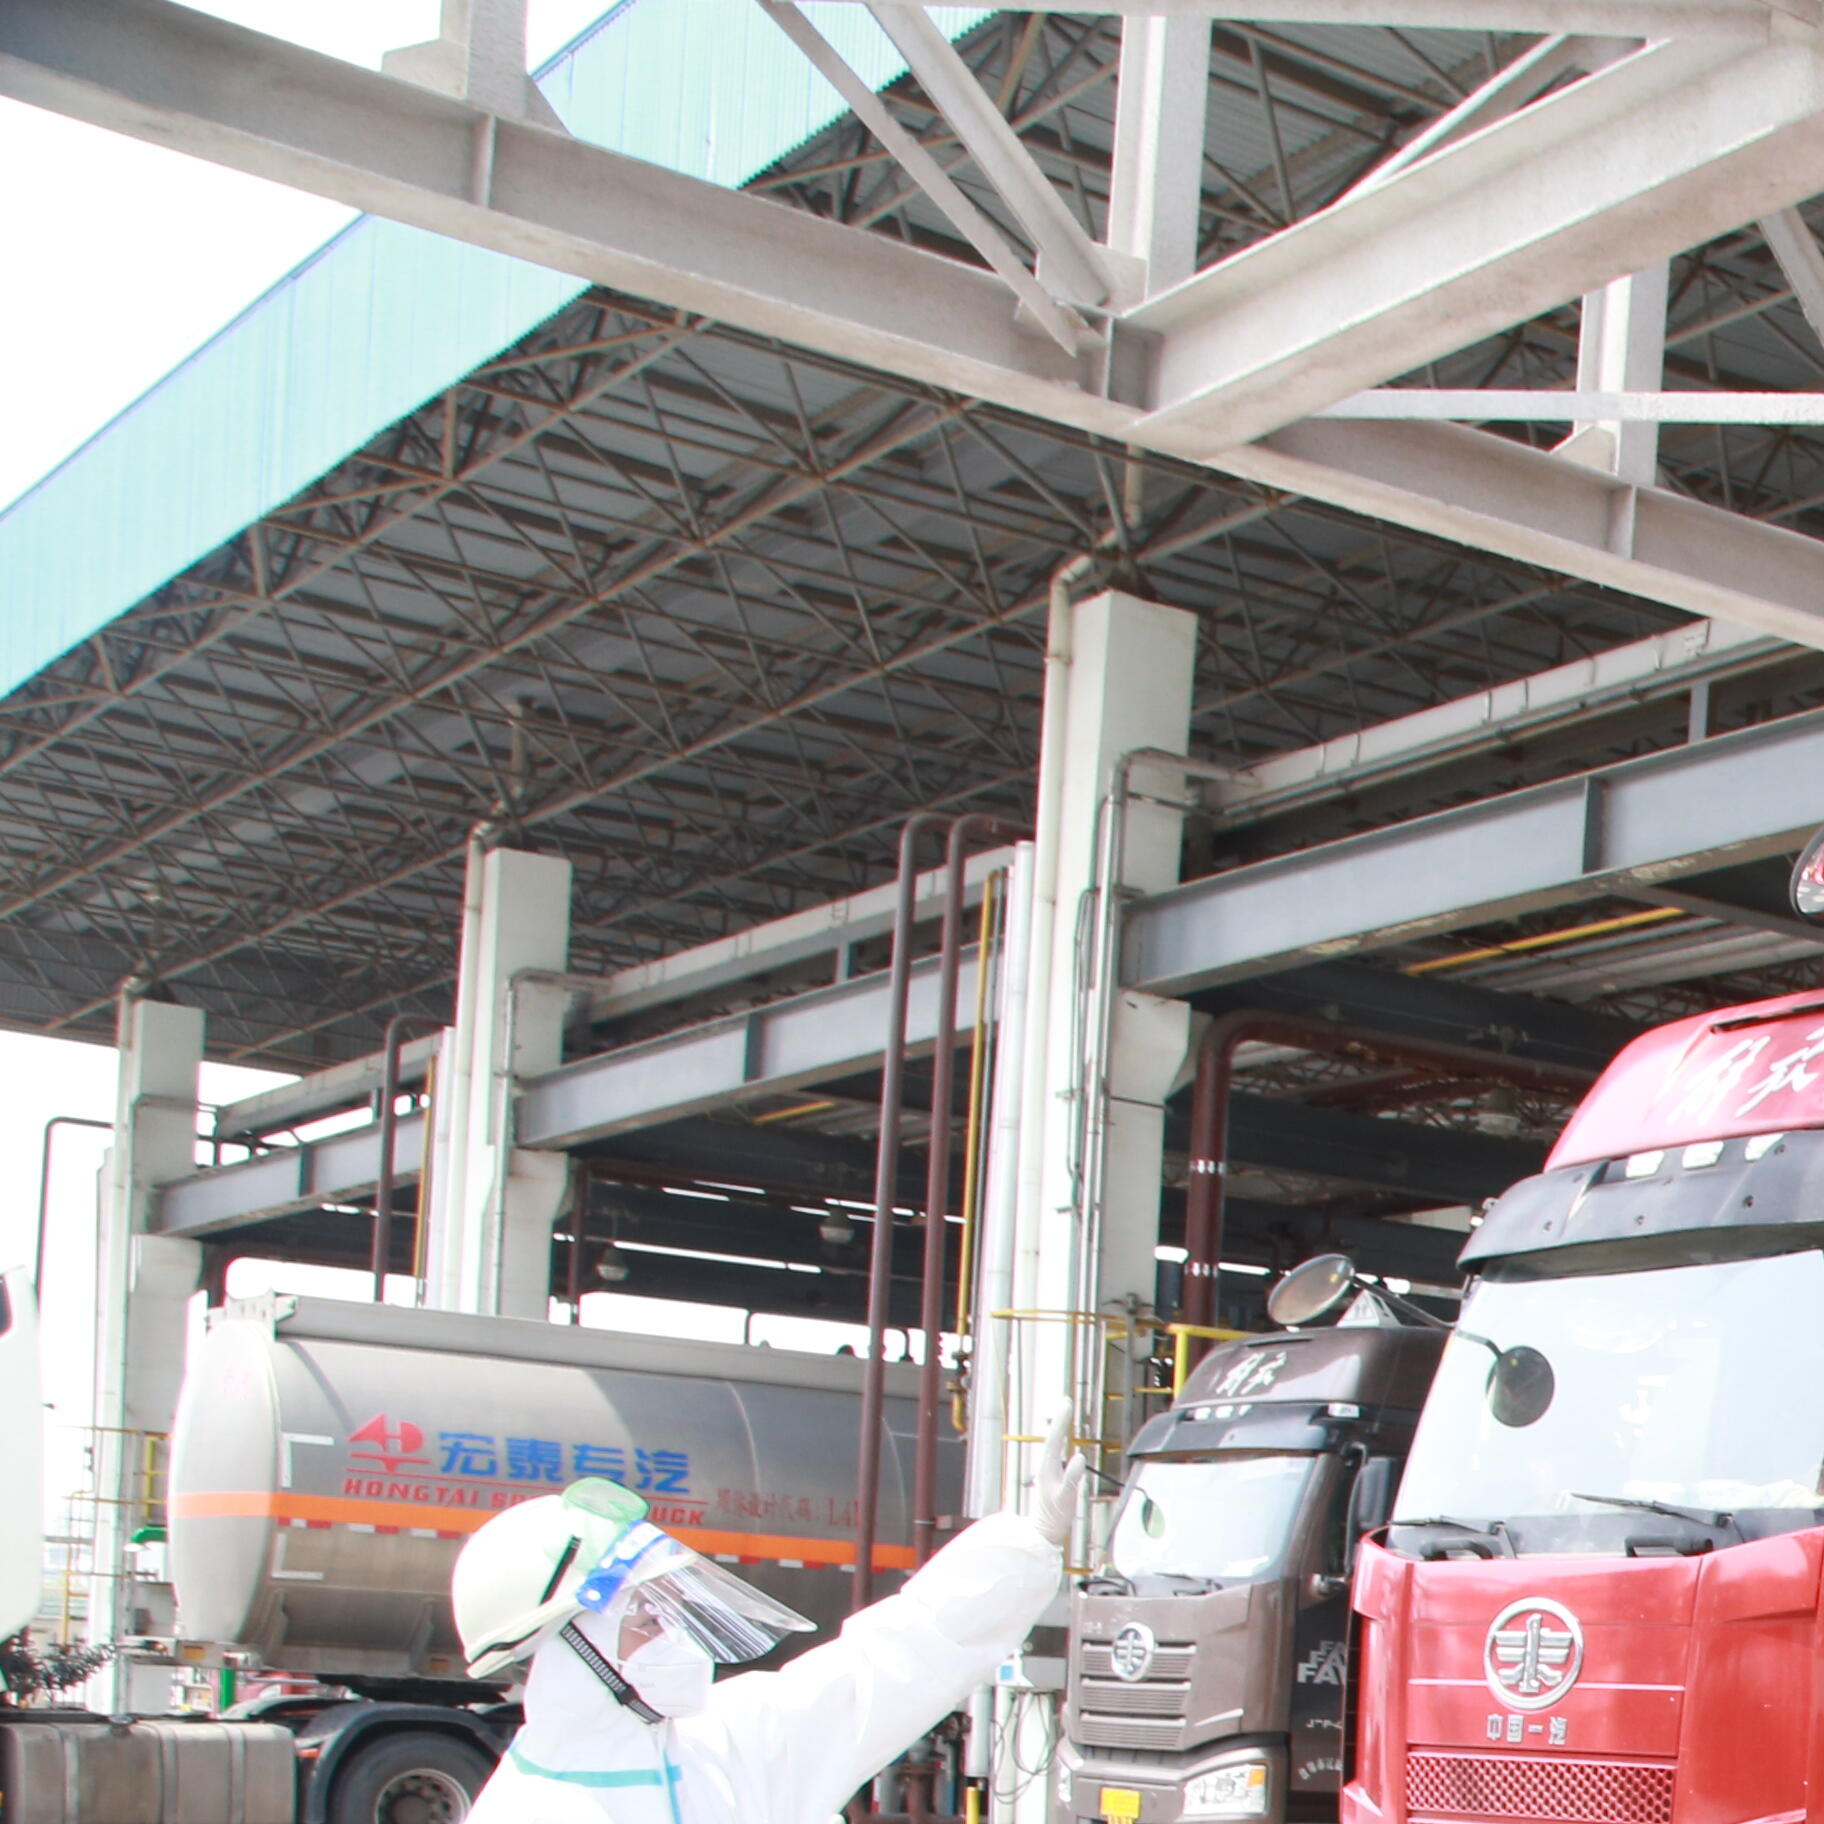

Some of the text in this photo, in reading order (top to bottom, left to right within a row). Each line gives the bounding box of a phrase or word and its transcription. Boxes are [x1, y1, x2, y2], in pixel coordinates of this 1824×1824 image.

[439, 1432, 690, 1495] 宏泰专汽
[343, 1478, 479, 1507] HONGTAI
[1486, 1714, 1568, 1746] 中国一汽
